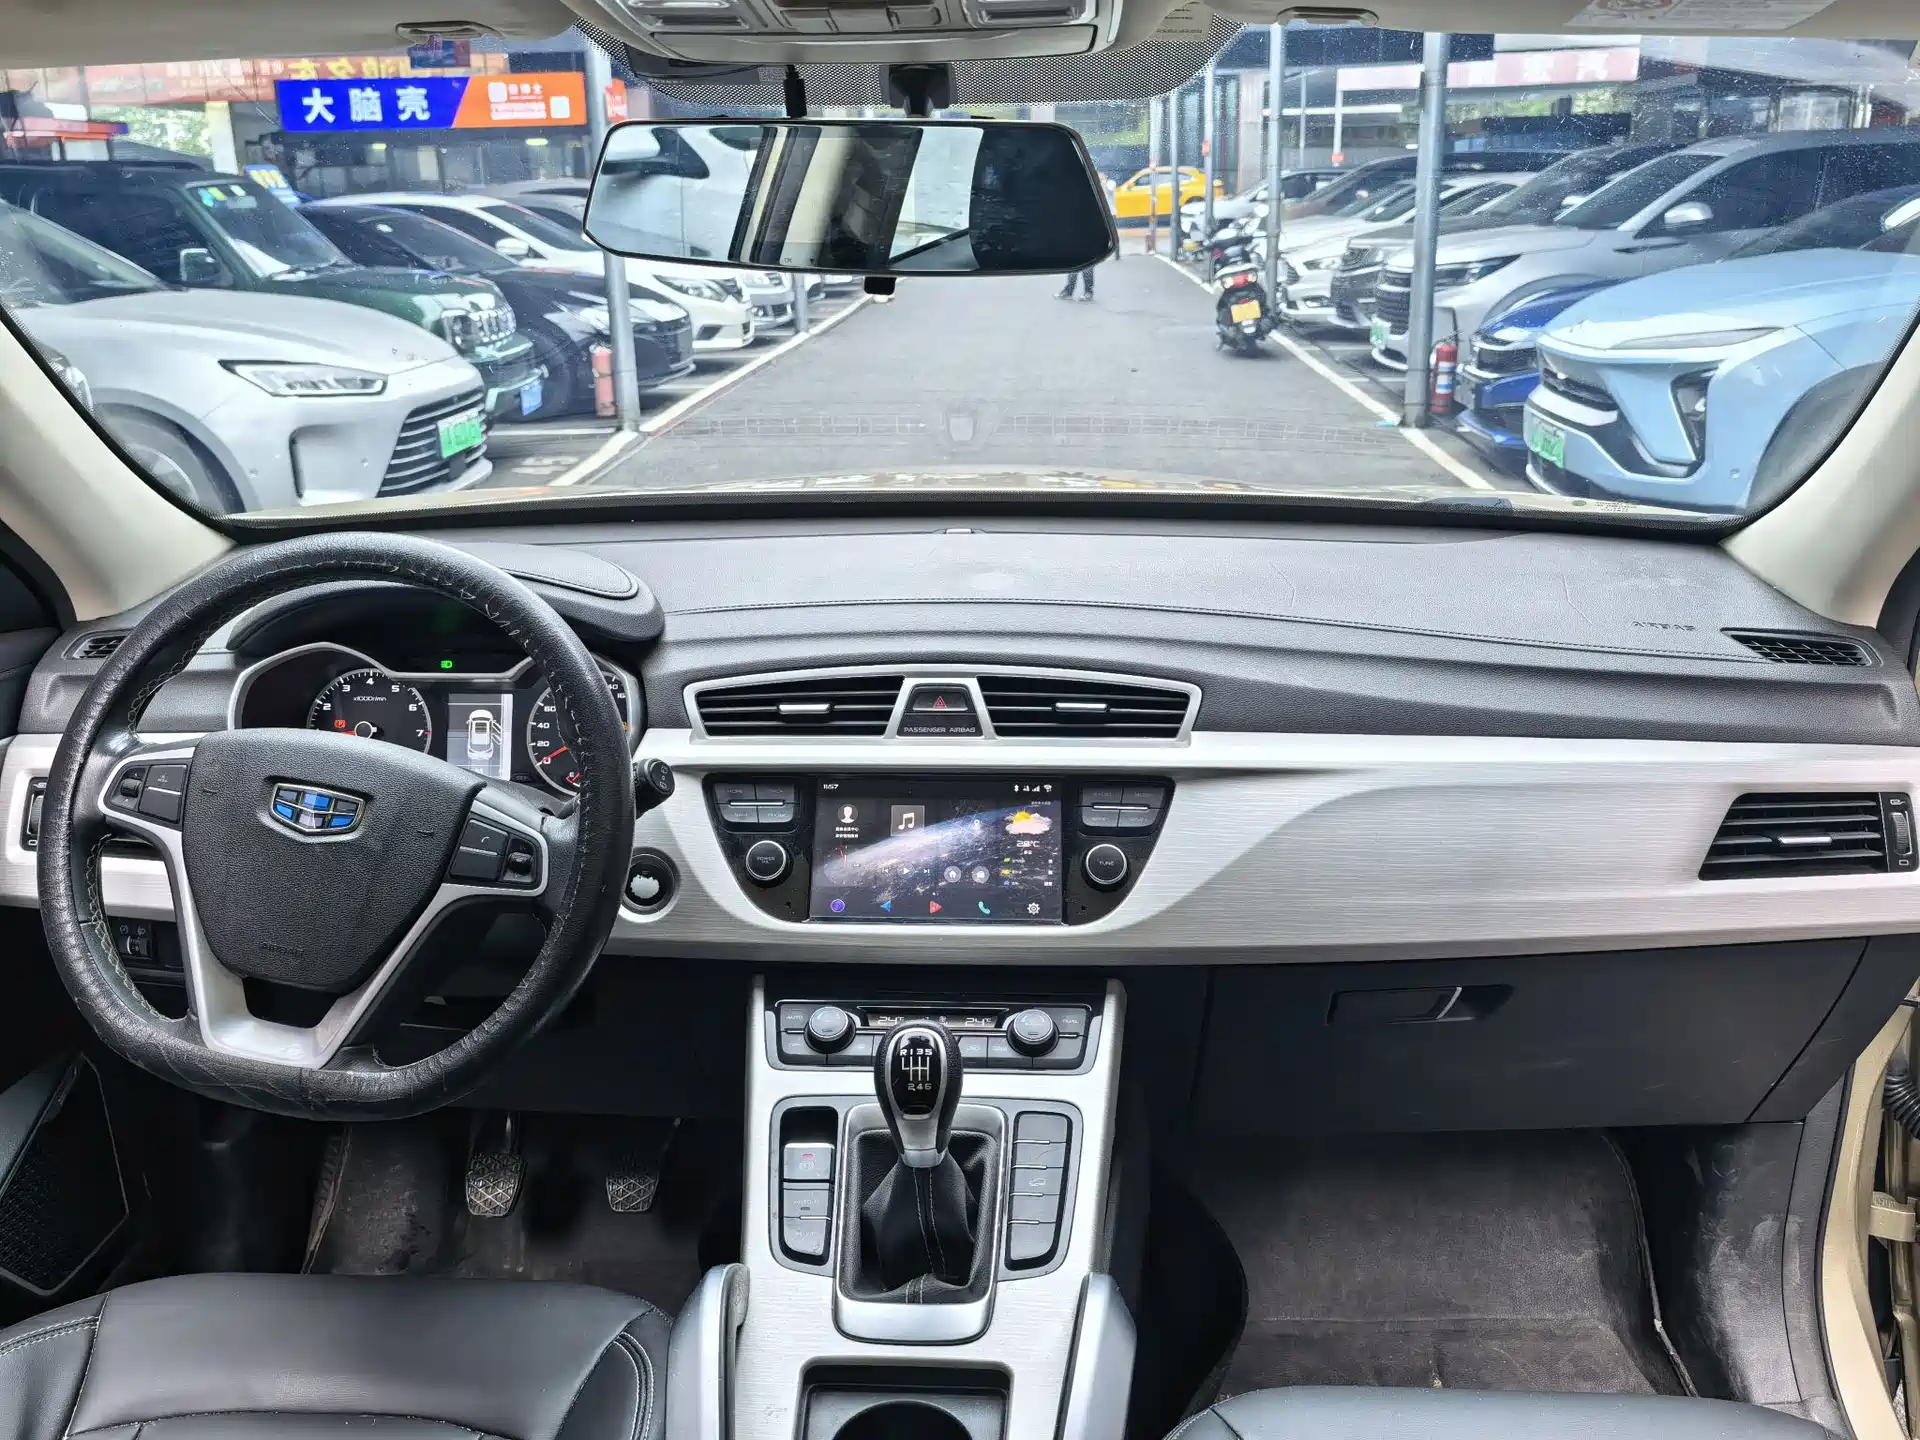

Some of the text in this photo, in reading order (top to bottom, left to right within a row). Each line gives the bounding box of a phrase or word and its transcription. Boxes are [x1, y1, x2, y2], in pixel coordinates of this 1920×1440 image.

[302, 82, 431, 123] 大脑壳
[366, 677, 375, 685] 4
[342, 684, 351, 692] 3
[391, 684, 400, 693] 5
[322, 702, 332, 711] 2
[408, 703, 418, 712] 6
[415, 729, 425, 737] 7
[543, 756, 552, 765] 0
